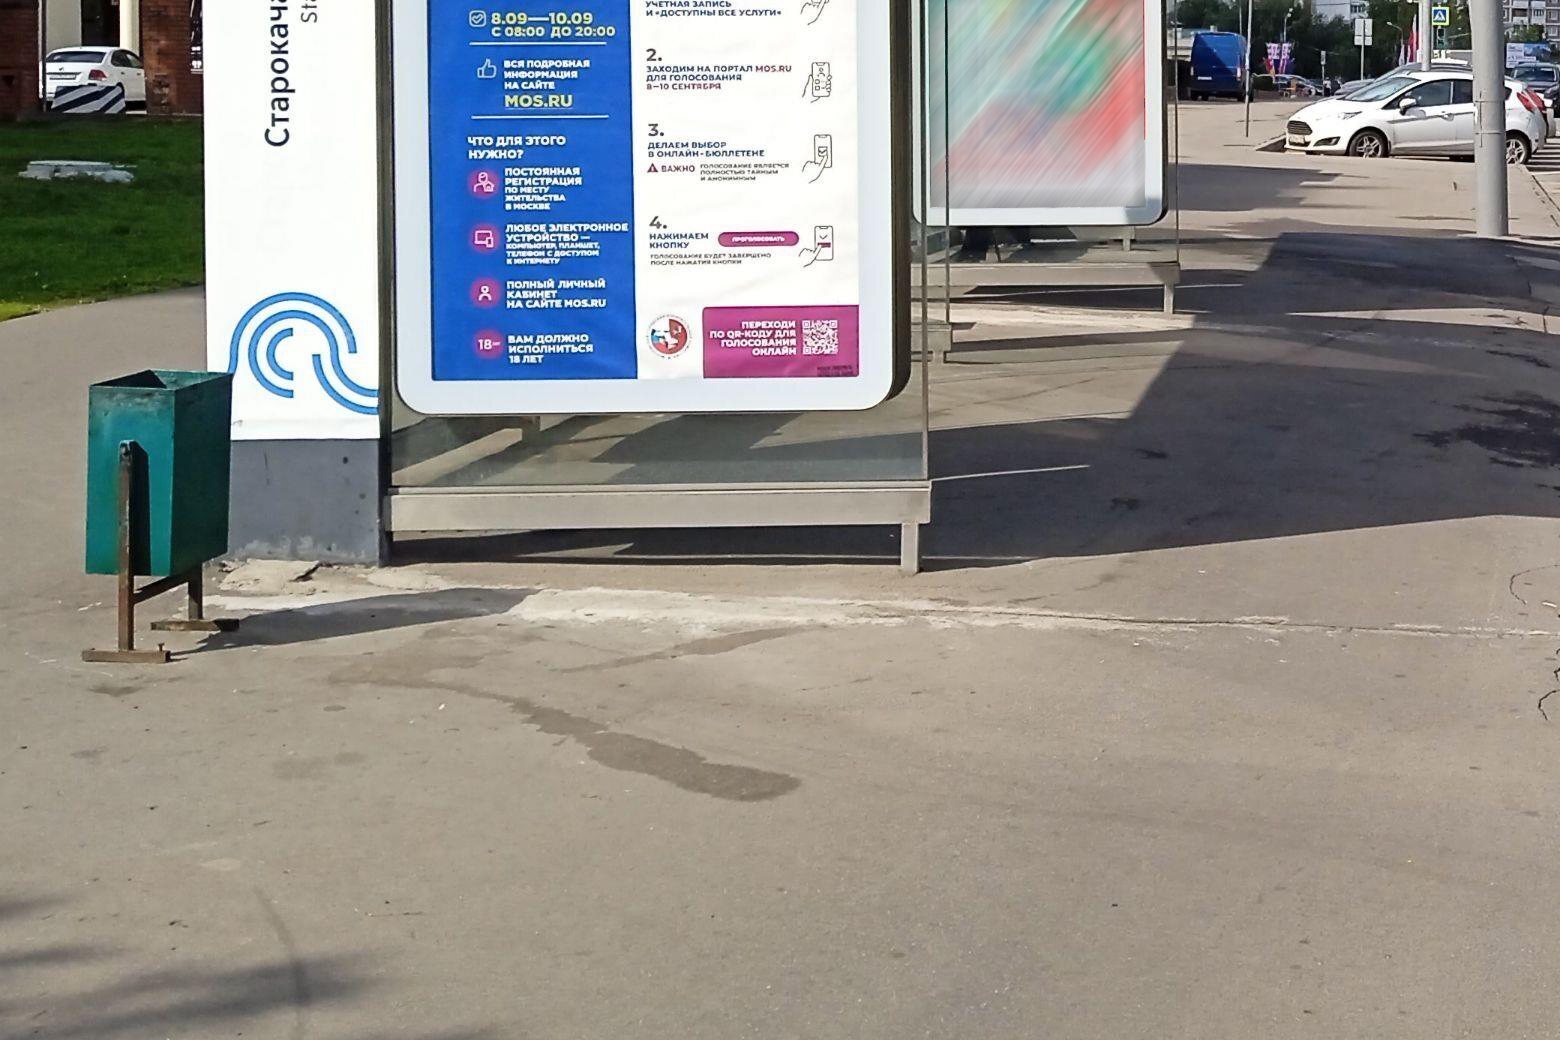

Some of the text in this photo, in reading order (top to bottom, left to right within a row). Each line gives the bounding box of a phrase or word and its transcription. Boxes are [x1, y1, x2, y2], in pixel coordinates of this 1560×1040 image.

[491, 26, 616, 39] С 08:00 ДО 20:00
[646, 48, 663, 61] 2.
[504, 59, 590, 69] ВСЯ ПОДРОБНАЯ
[504, 71, 578, 79] ИНФОРМАЦИЯ
[521, 80, 555, 90] САЙТЕ
[504, 95, 573, 107] MOS.RU
[648, 123, 665, 137] 3.
[468, 136, 567, 147] ЧТО ДЛЯ ЭТОГО
[648, 141, 727, 150] ДЕЛАЕМ ВЫБОР
[468, 150, 524, 159] НУЖНО?
[505, 167, 581, 176] ПОСТОЯННАЯ
[661, 165, 695, 173] ВАЖНО
[505, 177, 582, 186] РЕГИСТРАЦИЯ
[505, 222, 629, 232] ЛЮБОЕ ЭЛЕКТРОННОЕ
[649, 216, 667, 229] 4.
[506, 232, 579, 242] УСТРОЙСТВО
[506, 277, 606, 288] ПОЛНЫЙ ЛИЧНЫЙ
[506, 290, 557, 299] КАБИНЕТ
[525, 298, 562, 308] САЙТЕ
[564, 300, 606, 308] MOS.RU
[741, 321, 796, 330] ПЕРЕХОДИ
[726, 330, 772, 339] QR-КОДУ
[774, 330, 796, 338] ДЛЯ
[508, 336, 533, 344] ВАМ
[535, 335, 589, 344] ДОЛЖНО
[720, 339, 797, 347] ГОЛОСОВАНИЯ
[508, 344, 593, 353] ИСПОЛНИТЬСЯ
[752, 346, 797, 356] ОНЛАЙН
[509, 355, 544, 363] 18 ЛЕТ
